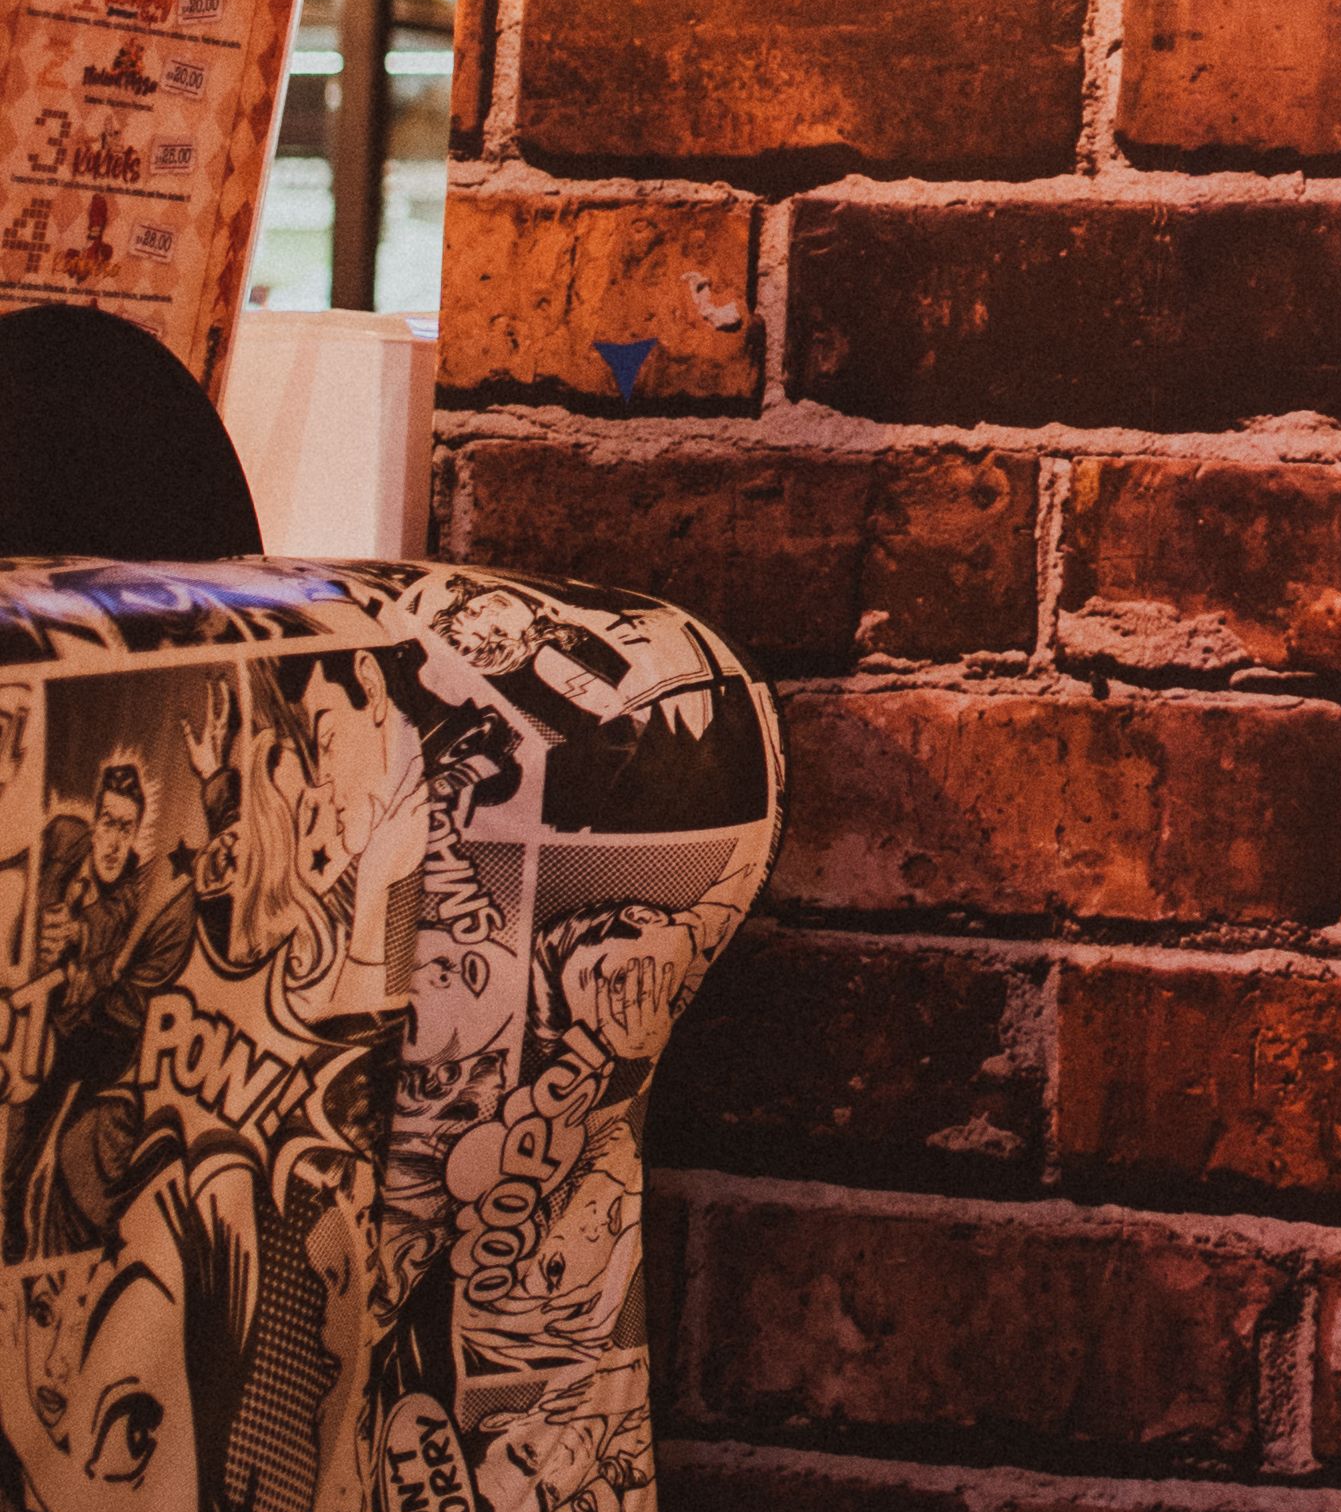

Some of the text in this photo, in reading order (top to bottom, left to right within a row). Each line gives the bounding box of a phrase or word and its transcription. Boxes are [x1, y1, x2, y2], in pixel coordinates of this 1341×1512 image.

[27, 108, 72, 175] 3
[141, 991, 318, 1141] POW!
[464, 1030, 612, 1306] OOOPS!
